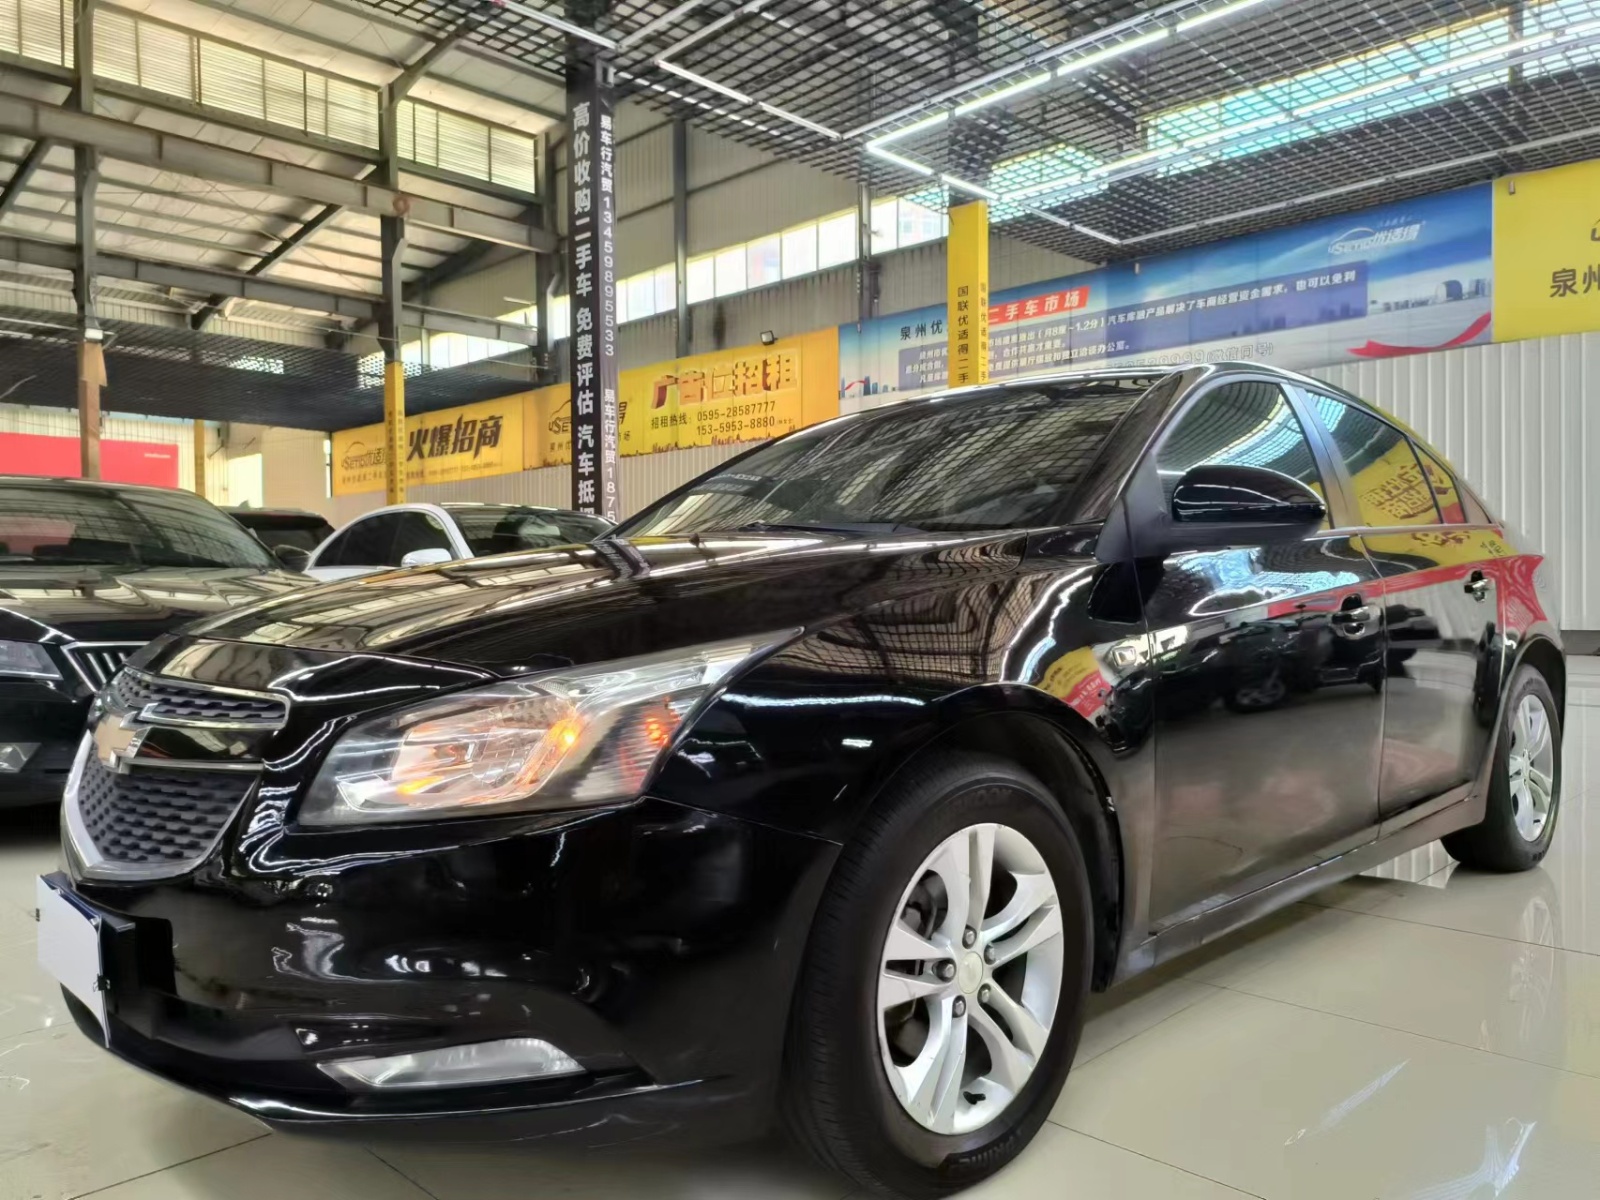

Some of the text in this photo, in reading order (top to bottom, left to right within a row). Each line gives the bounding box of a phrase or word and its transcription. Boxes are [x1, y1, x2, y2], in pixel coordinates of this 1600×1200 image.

[573, 102, 595, 516] 高价收购二手车 免费评估 汽车抵
[697, 401, 776, 422] 0595-28587777
[697, 416, 776, 436] 153-5953-8880
[406, 414, 503, 461] 火爆招商
